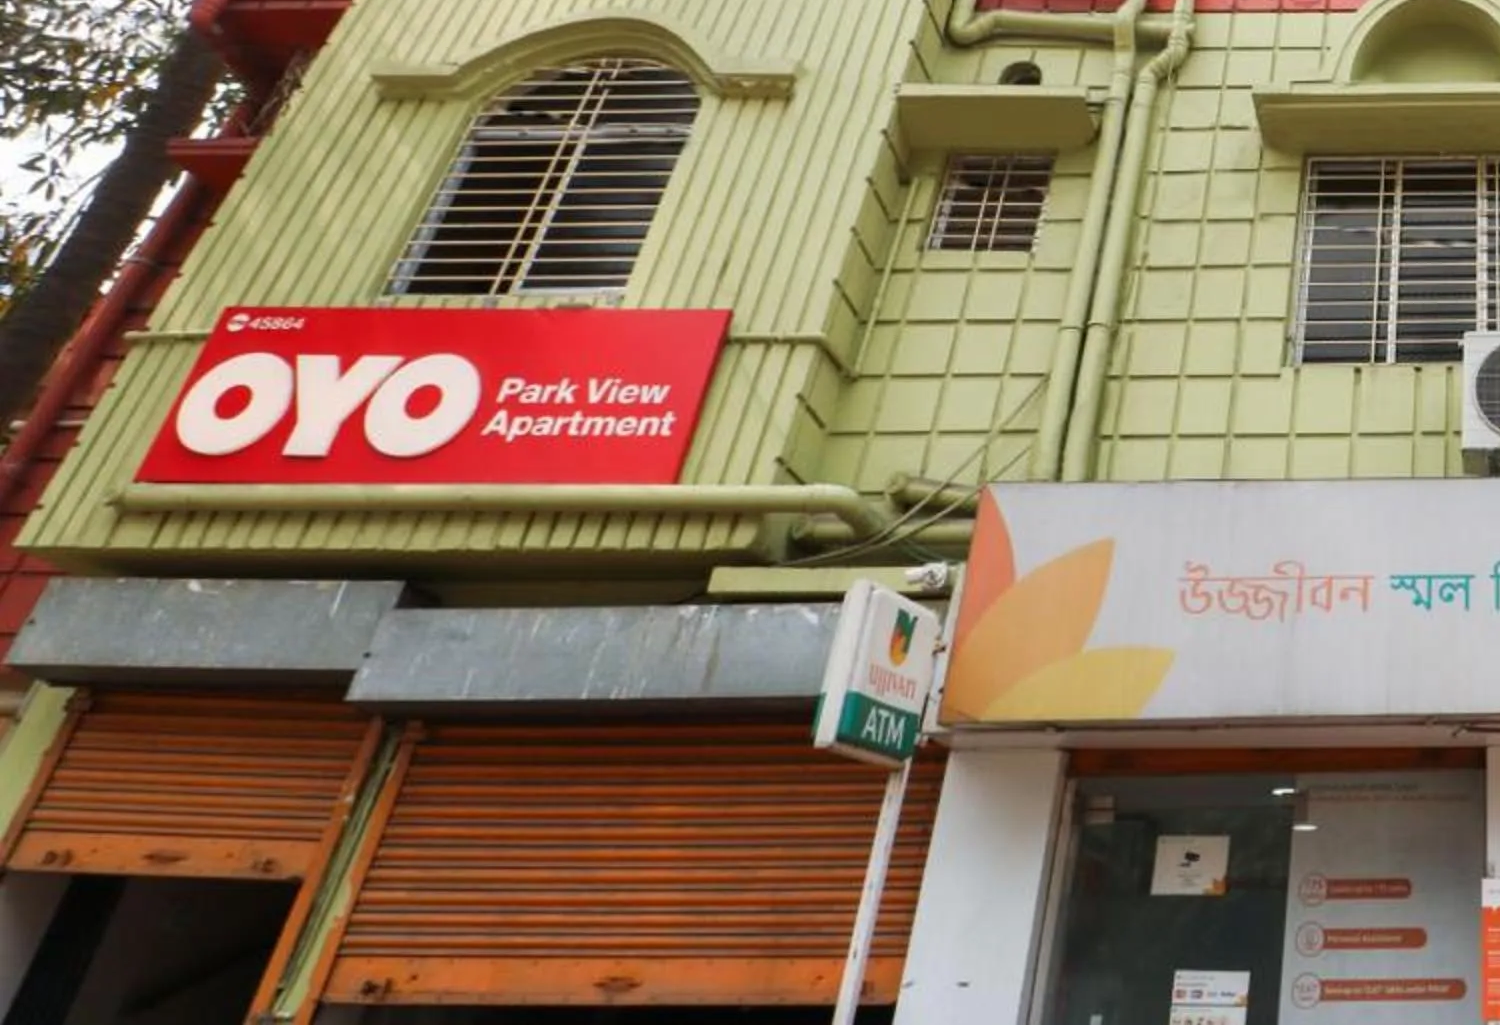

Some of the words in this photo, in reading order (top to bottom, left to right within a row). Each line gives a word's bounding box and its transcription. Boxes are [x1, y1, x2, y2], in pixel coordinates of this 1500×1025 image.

[176, 352, 480, 457] OYO
[496, 377, 579, 405] Park
[587, 377, 672, 405] View
[480, 408, 676, 442] Apartment
[1179, 560, 1375, 623] উজ্জীবন
[1389, 574, 1475, 611] স্মল
[860, 705, 908, 750] ATM
